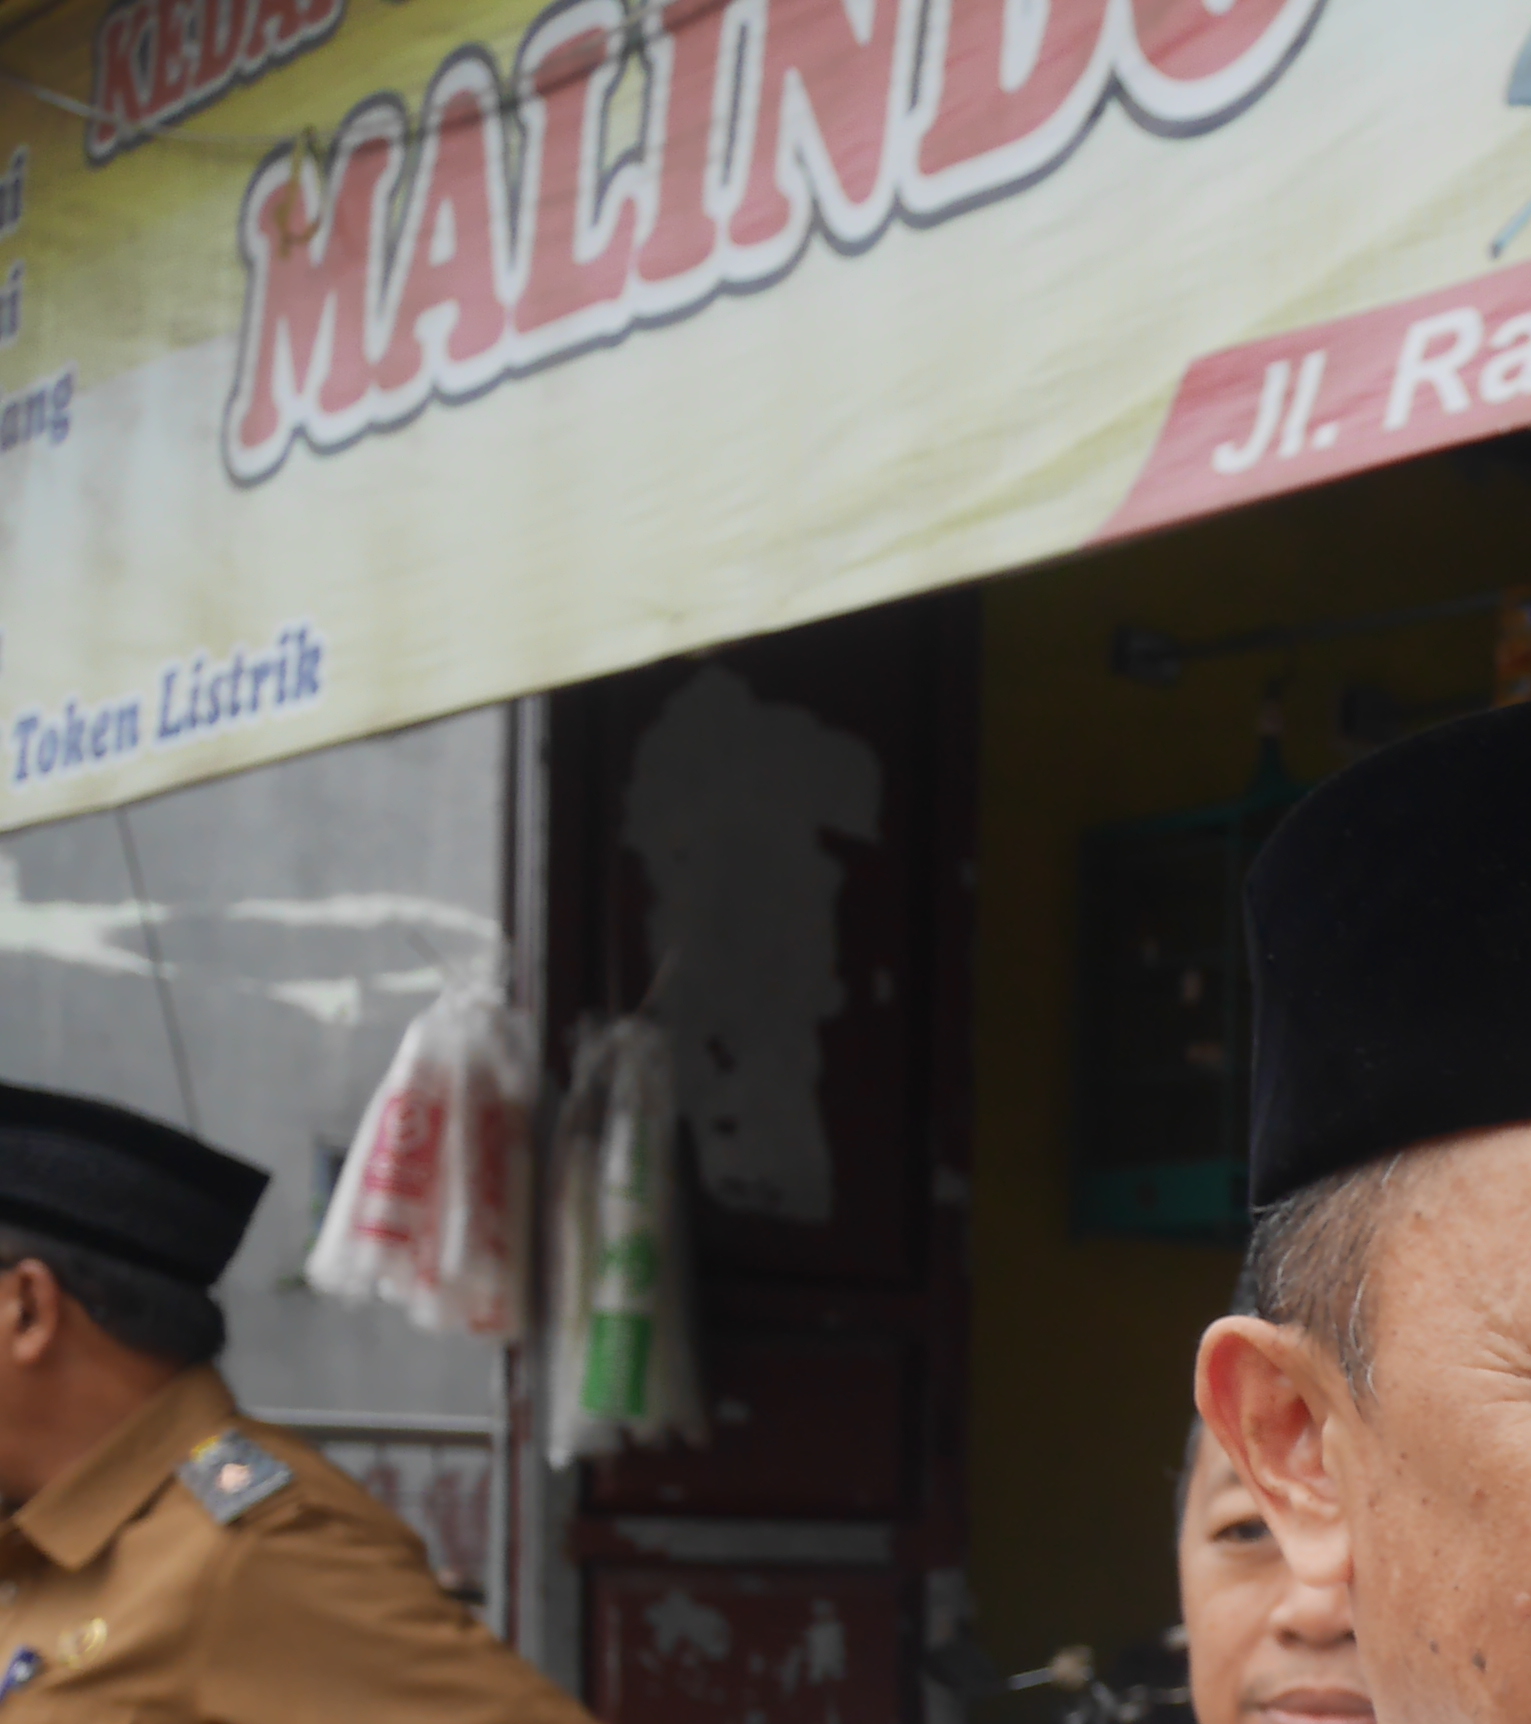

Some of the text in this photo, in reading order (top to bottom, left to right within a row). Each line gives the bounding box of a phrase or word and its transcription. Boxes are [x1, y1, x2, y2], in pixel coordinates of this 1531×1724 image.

[230, 0, 1310, 465] MALIND
[1212, 350, 1339, 474] Jl.
[16, 628, 320, 782] Token Listrik
